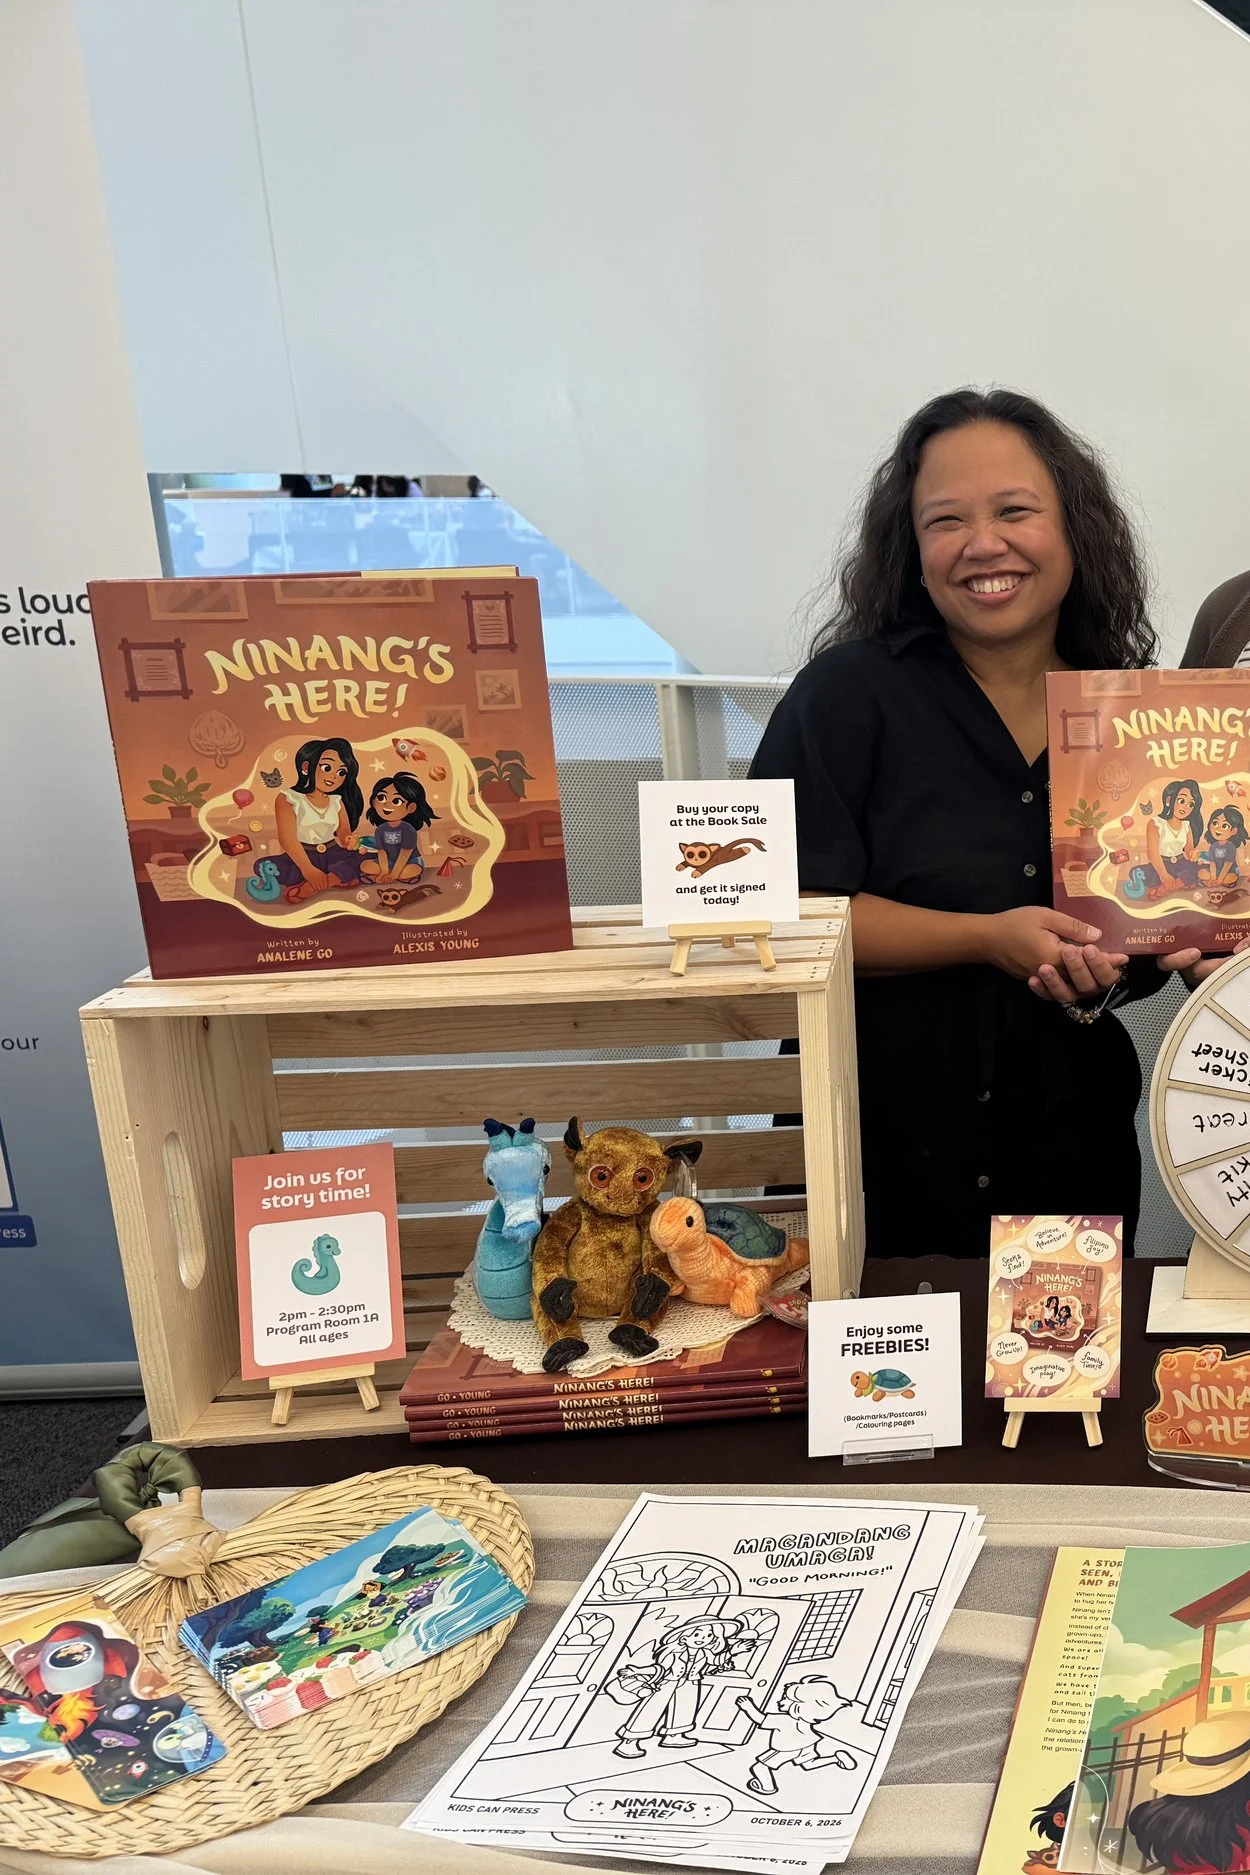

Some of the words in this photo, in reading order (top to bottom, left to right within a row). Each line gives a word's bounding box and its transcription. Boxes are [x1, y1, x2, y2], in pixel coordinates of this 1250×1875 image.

[204, 635, 454, 694] NINANG'S
[264, 679, 408, 723] HERE!
[1146, 737, 1238, 770] HERE!
[676, 805, 699, 815] Buy
[702, 804, 728, 815] your
[731, 804, 759, 814] copy
[669, 819, 683, 827] at
[685, 818, 705, 826] the
[708, 817, 738, 826] Book
[741, 816, 767, 825] Sale
[676, 885, 697, 894] and
[700, 884, 717, 895] get
[720, 884, 727, 892] it
[730, 883, 766, 894] signed
[703, 895, 739, 905] today!
[457, 928, 468, 937] by
[1215, 931, 1243, 941] ALEXIS
[308, 938, 319, 947] by
[393, 941, 436, 954] ALEXIS
[440, 938, 480, 950] YOUNG
[1125, 935, 1162, 945] ANALENE
[1165, 934, 1175, 943] GO
[256, 949, 313, 963] ANALENE
[317, 948, 333, 959] GO
[263, 1172, 305, 1191] Join
[309, 1172, 332, 1185] us
[335, 1167, 366, 1182] for
[261, 1193, 314, 1210] story
[319, 1184, 371, 1203] time!
[1036, 1272, 1083, 1288] NINANG'S
[1044, 1282, 1072, 1293] HERE!
[278, 1311, 307, 1324] 2pm
[318, 1303, 366, 1318] 2:30pm
[266, 1322, 321, 1337] Program
[324, 1316, 360, 1329] Room
[363, 1312, 379, 1324] 1A
[299, 1334, 317, 1345] All
[319, 1330, 349, 1345] ages
[846, 1325, 884, 1339] Enjoy
[887, 1324, 923, 1335] some
[841, 1338, 929, 1357] FREEBIES!
[553, 1380, 615, 1394] NINANG'S
[618, 1377, 654, 1389] HERE!
[437, 1393, 450, 1402] GO
[459, 1390, 491, 1400] YOUNG
[844, 1411, 927, 1422] (Bookmarks/Postcards)
[893, 1419, 915, 1428] pages
[733, 1524, 911, 1554] MAGANDANG
[765, 1546, 875, 1569] UMAGA!
[1080, 1569, 1113, 1578] SEEN,
[1078, 1578, 1103, 1587] AND
[447, 1803, 475, 1813] KIDS
[477, 1804, 500, 1813] CAN
[502, 1806, 540, 1815] PRESS
[611, 1797, 697, 1813] NINANG'S
[624, 1808, 675, 1820] HERE!
[751, 1817, 802, 1826] OCTOBER
